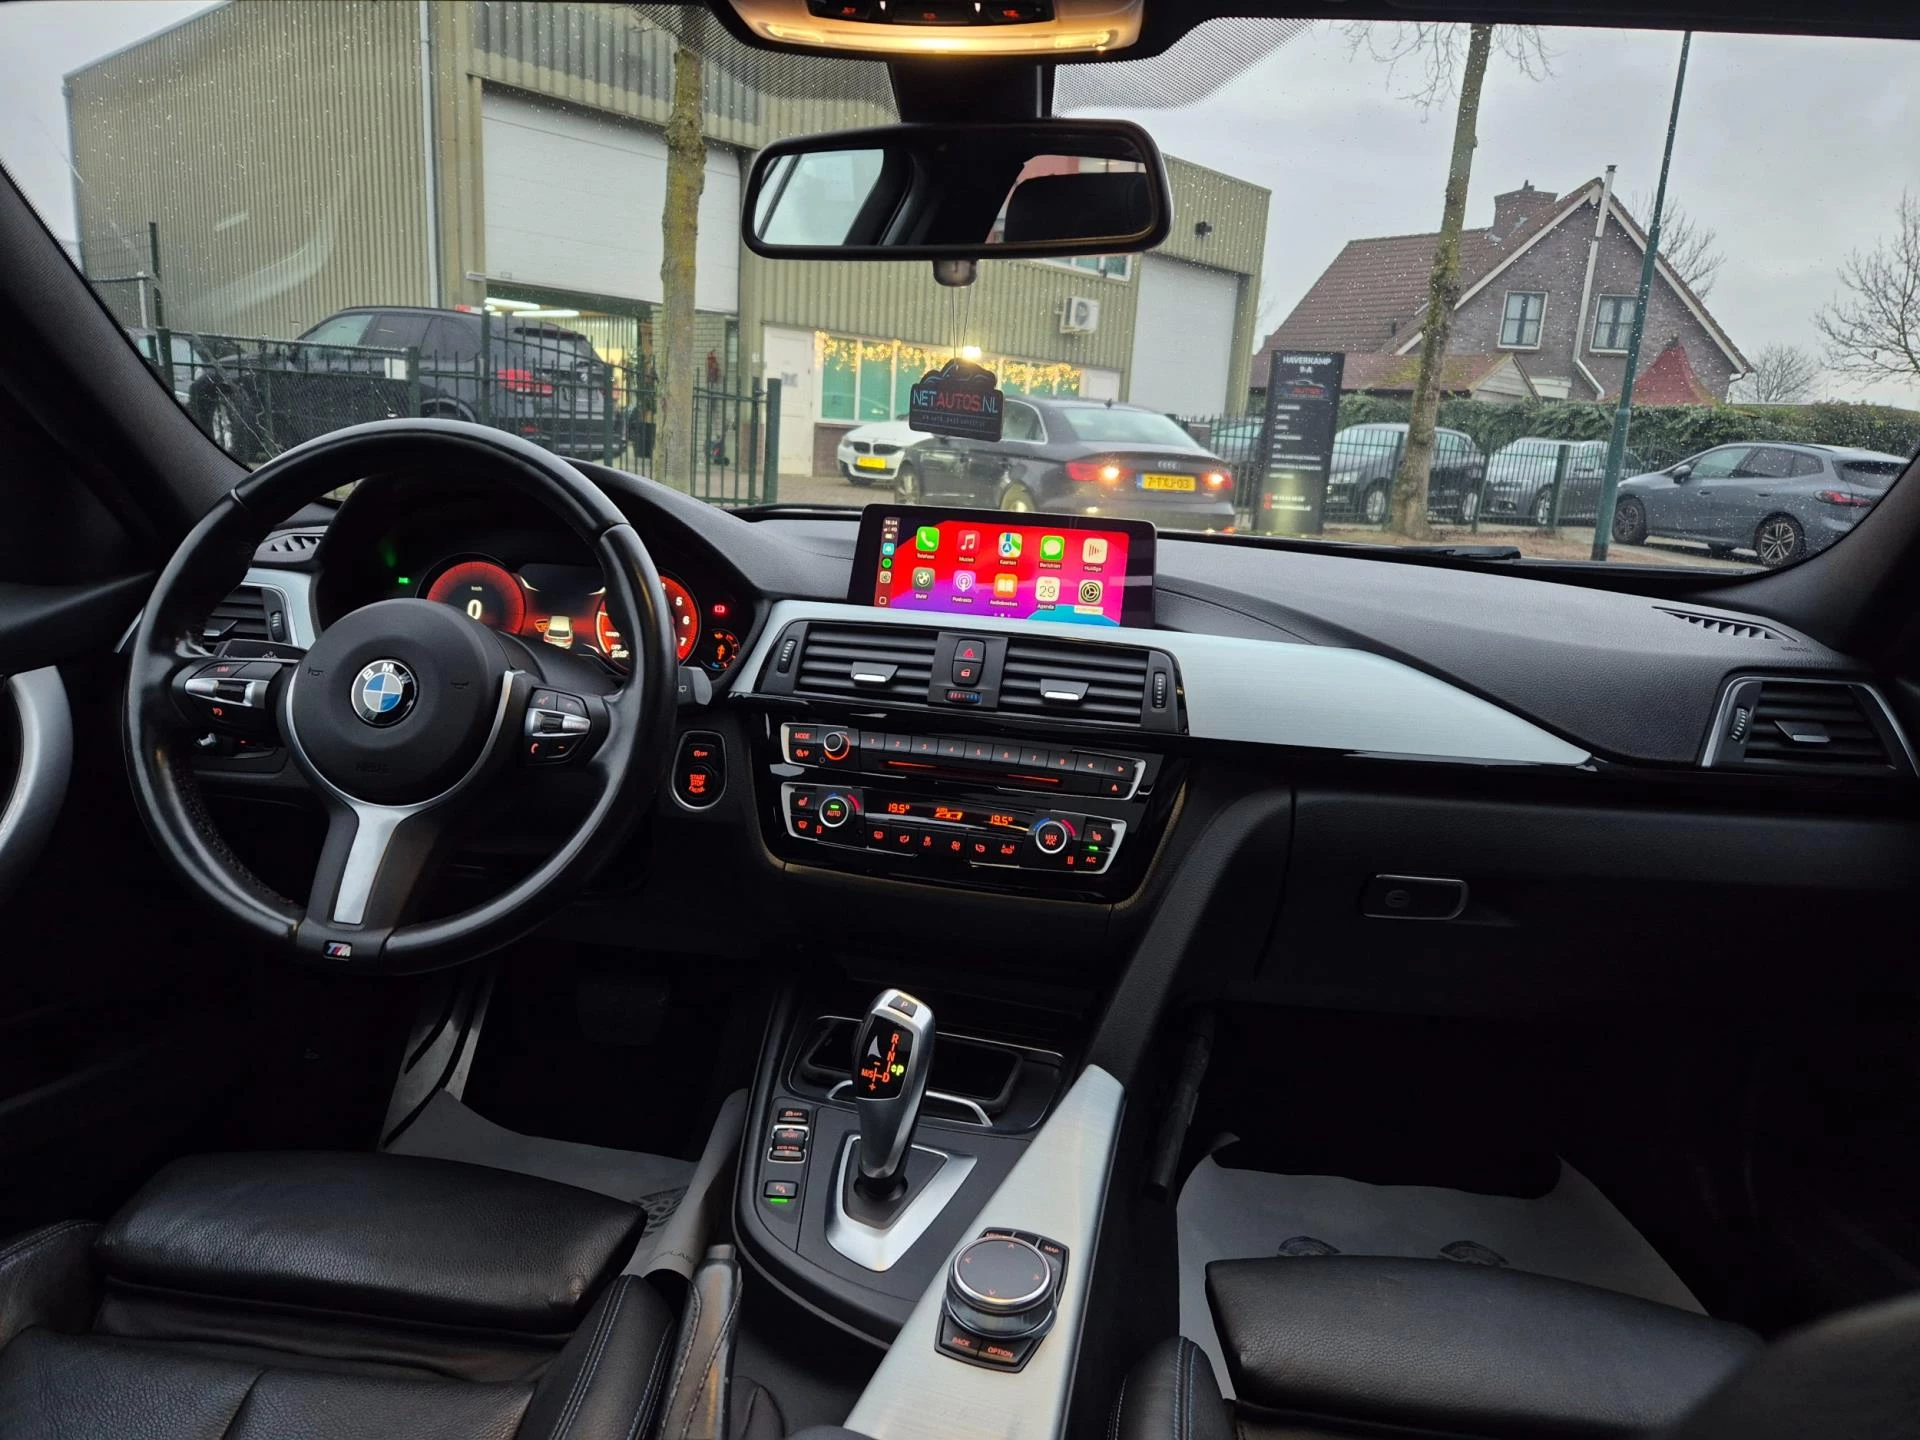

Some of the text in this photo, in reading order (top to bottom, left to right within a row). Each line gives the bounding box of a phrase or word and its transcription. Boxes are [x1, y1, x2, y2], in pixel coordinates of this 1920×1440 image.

[1039, 585, 1056, 598] 29
[675, 596, 683, 606] 5
[467, 599, 482, 620] 0
[682, 615, 690, 625] 6
[680, 637, 687, 646] 7
[362, 662, 412, 684] BMW
[900, 1000, 908, 1008] P
[891, 1033, 899, 1045] R
[886, 1050, 896, 1062] N
[881, 1071, 891, 1083] D
[781, 1131, 799, 1139] SPORT
[1044, 1245, 1060, 1254] MAP
[951, 1336, 971, 1346] BACK
[987, 1346, 1014, 1358] OPTION
